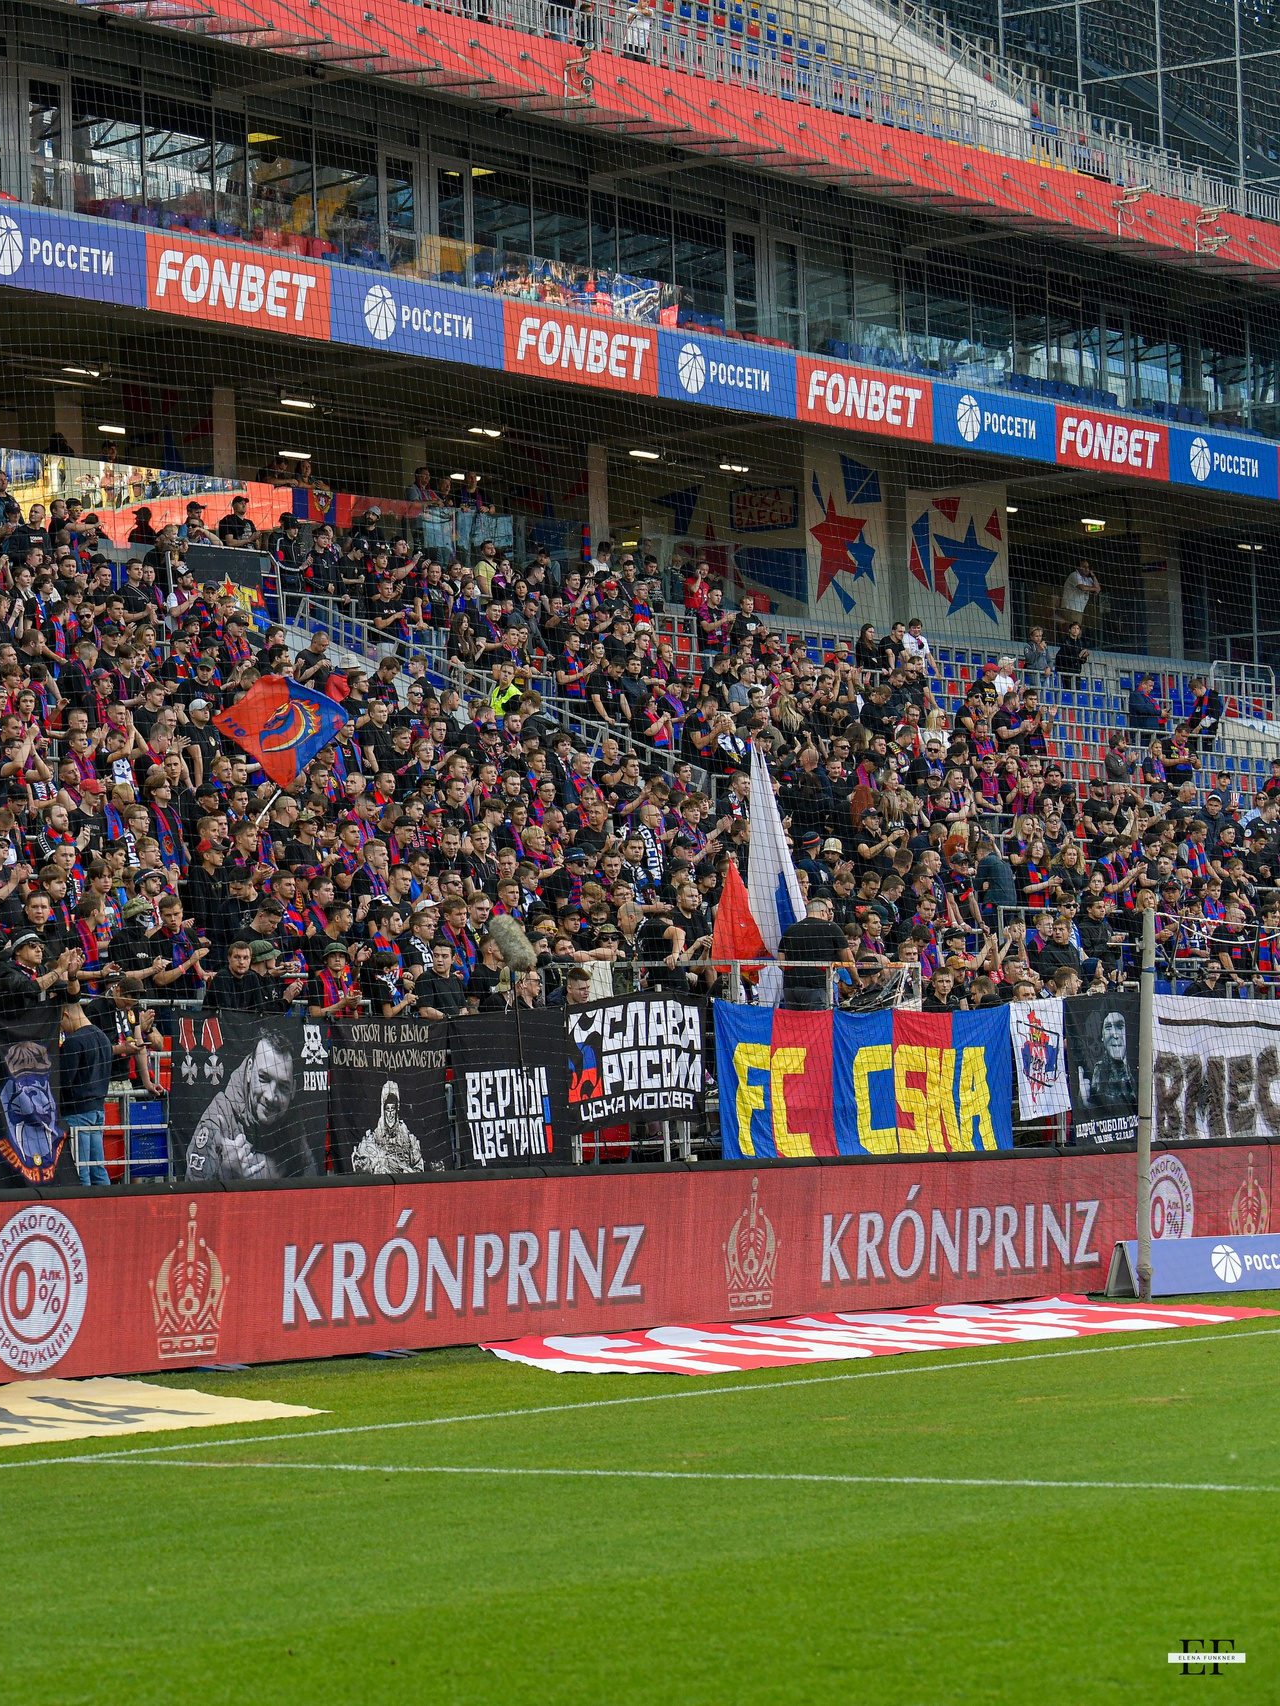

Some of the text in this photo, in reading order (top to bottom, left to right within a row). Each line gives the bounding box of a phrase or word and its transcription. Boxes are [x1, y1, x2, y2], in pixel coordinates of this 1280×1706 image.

[29, 237, 114, 277] РОССЕТИ
[155, 249, 317, 321] FONBET
[401, 304, 473, 341] РОССЕТИ
[516, 316, 651, 381] FONBET
[709, 360, 770, 393] РОССЕТИ
[807, 369, 923, 428] FONBET
[984, 411, 1036, 440] РОССЕТИ
[1060, 416, 1160, 469] FONBET
[1213, 452, 1259, 478] РОССЕТИ
[351, 1023, 429, 1043] ОТБОЯ НЕ БЫЛО!
[601, 999, 703, 1051] СЛАВА
[332, 1045, 369, 1068] БОРЬБА
[303, 1070, 329, 1091] RBW
[733, 1042, 998, 1158] FC CSKA
[580, 1094, 627, 1123] ЦСКА
[468, 1116, 547, 1167] ЦВЕТАМ
[821, 1184, 1100, 1283] KRÓNPRINZ
[282, 1209, 645, 1324] KRÓNPRINZ
